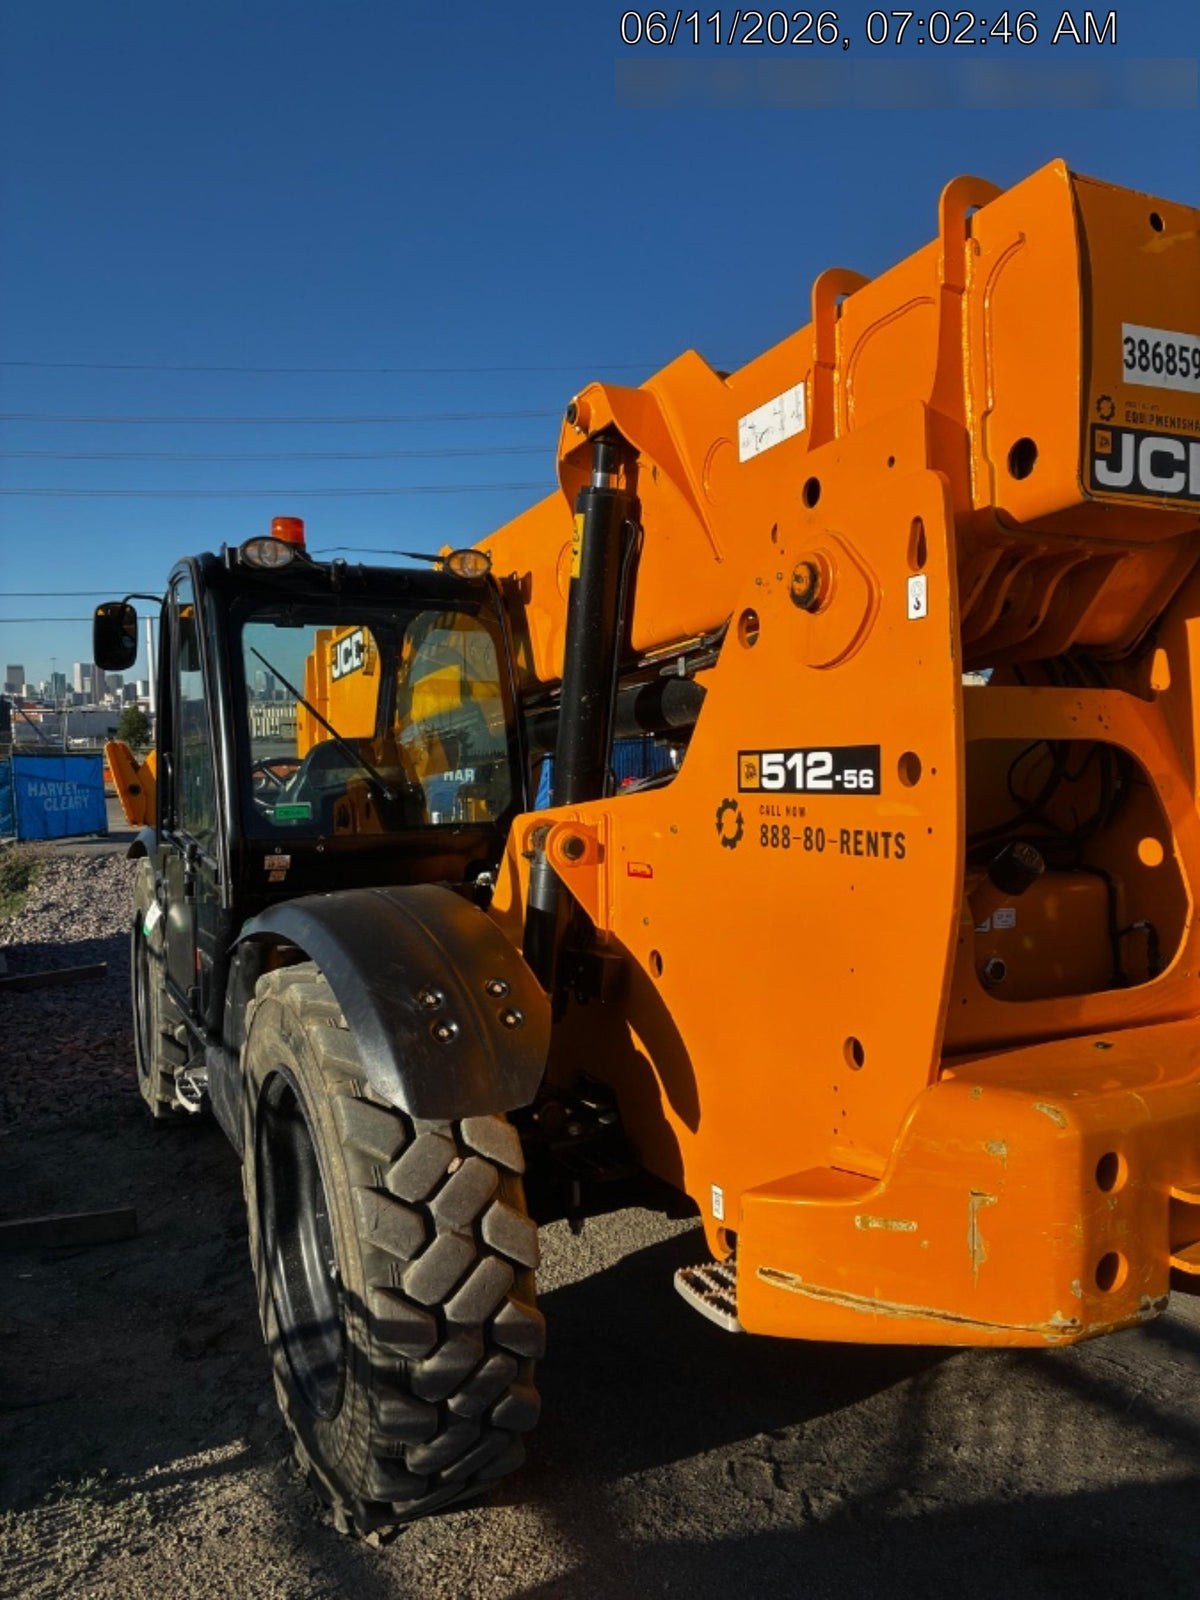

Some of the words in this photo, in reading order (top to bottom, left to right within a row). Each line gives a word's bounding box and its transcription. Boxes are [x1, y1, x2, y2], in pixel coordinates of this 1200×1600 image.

[1095, 433, 1200, 495] JC
[332, 630, 364, 678] JCB
[28, 782, 78, 797] HARVEY
[44, 796, 88, 812] CLEARY
[759, 804, 781, 817] CALL
[759, 823, 906, 860] 888-80-RENTS
